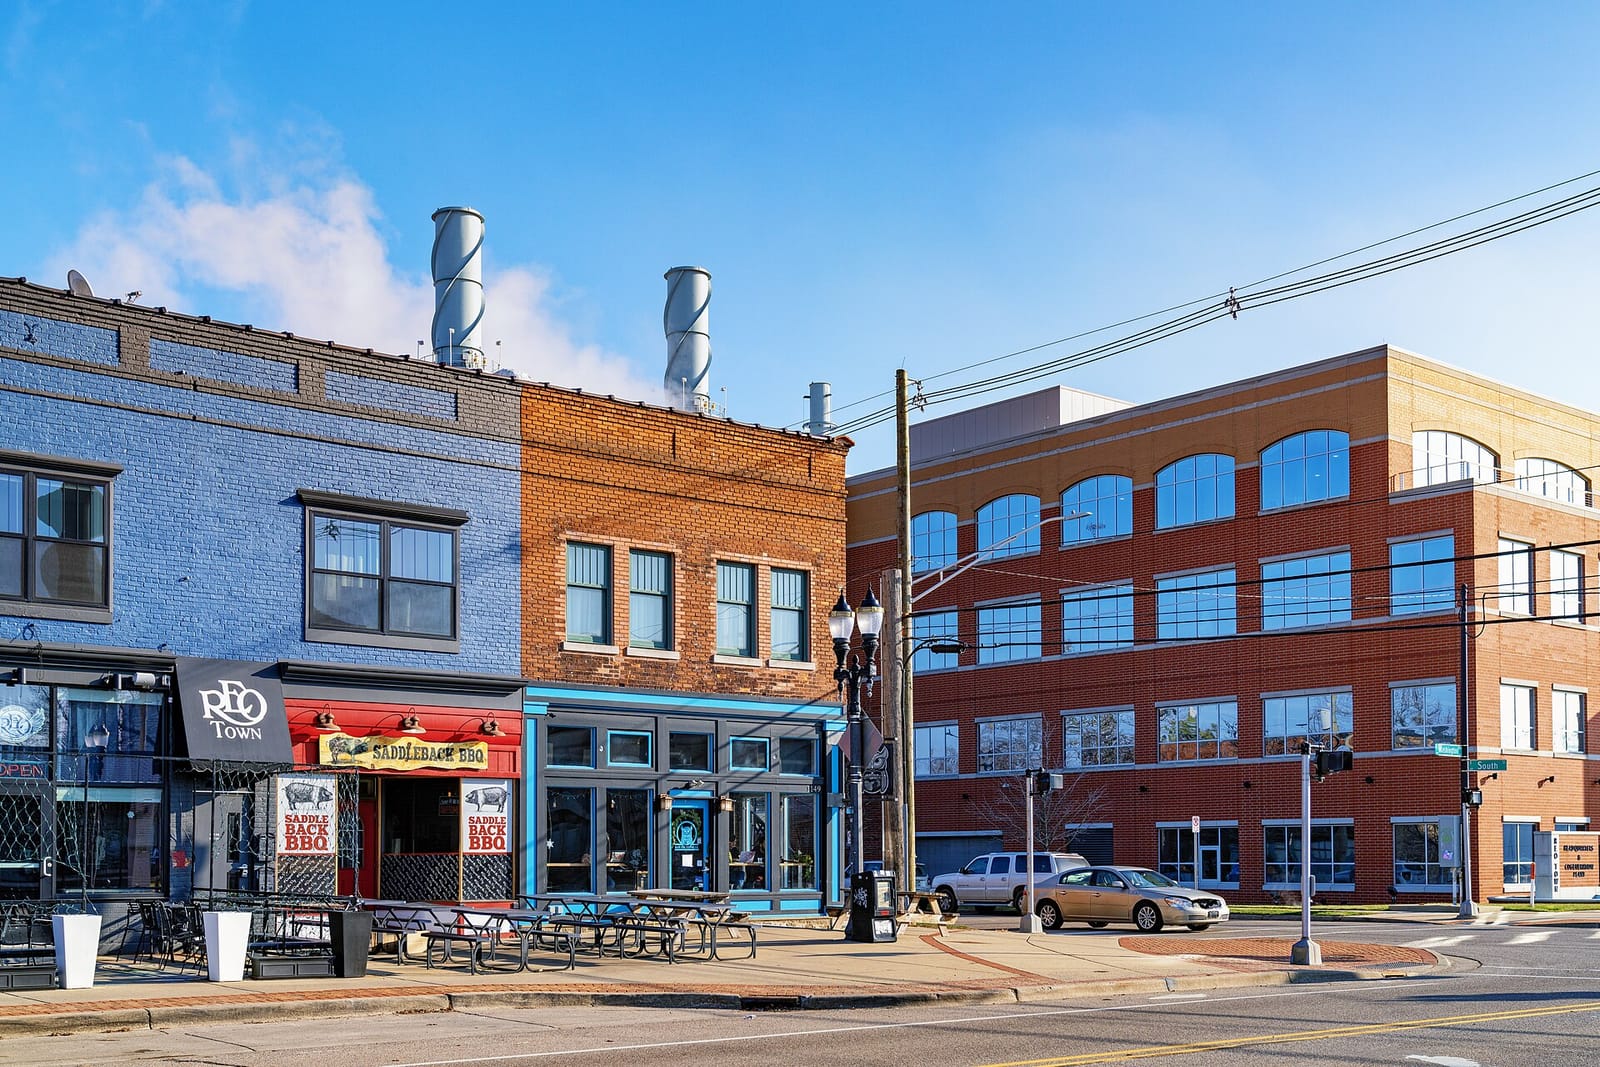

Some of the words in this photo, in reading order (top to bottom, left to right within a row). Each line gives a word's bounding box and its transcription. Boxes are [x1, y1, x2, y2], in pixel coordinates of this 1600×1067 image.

[199, 680, 267, 726] REO
[373, 742, 455, 762] SADDLEBACK
[459, 748, 484, 763] BBQ
[1477, 761, 1499, 770] South
[285, 815, 329, 823] SADDLE
[468, 816, 506, 824] SADDLE
[285, 824, 329, 835] BACK
[468, 825, 506, 836] BACK
[284, 836, 329, 850] BBQ
[468, 836, 506, 850] BBQ
